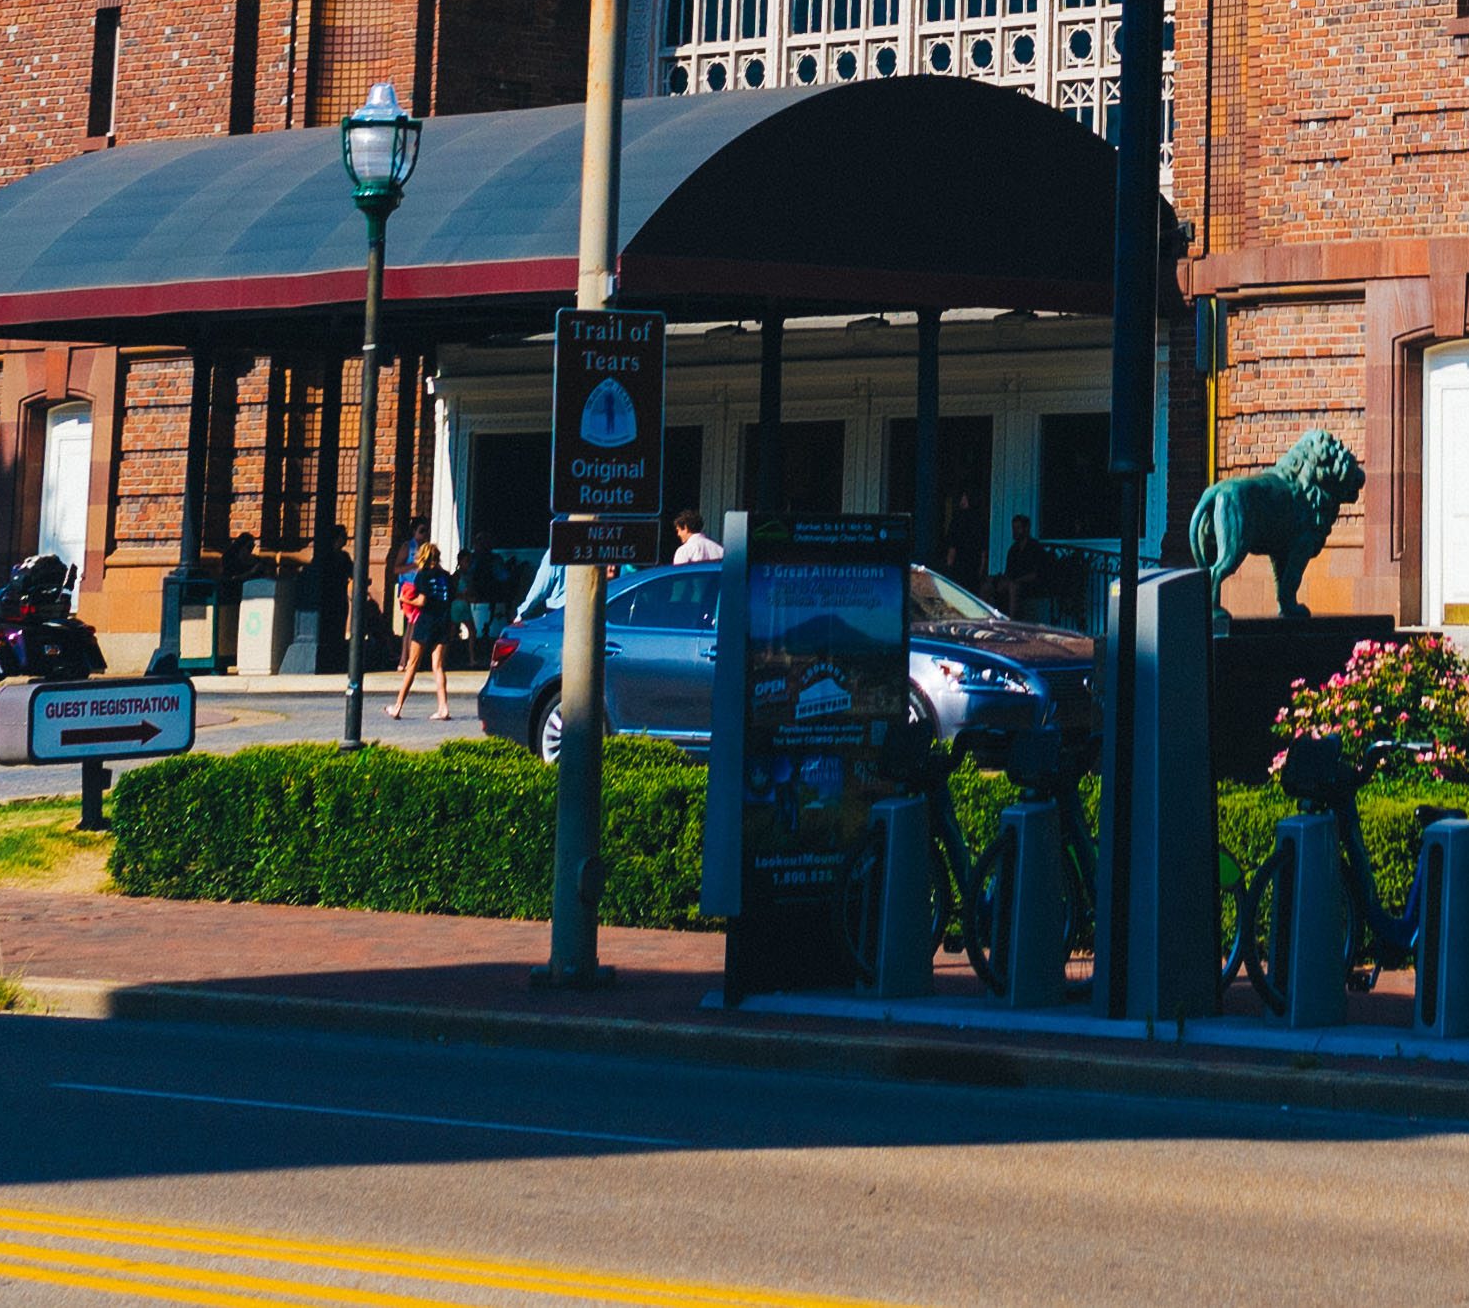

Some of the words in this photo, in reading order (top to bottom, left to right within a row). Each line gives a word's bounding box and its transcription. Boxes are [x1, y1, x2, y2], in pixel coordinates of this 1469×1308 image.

[570, 316, 623, 342] Trail
[630, 319, 653, 342] of
[581, 350, 640, 372] Tears
[571, 458, 645, 484] Original
[579, 484, 635, 505] Route
[588, 526, 624, 541] NEXT
[573, 545, 594, 559] 3.3
[598, 545, 637, 559] MILES
[762, 565, 771, 578] 3
[774, 565, 809, 578] Great
[811, 565, 885, 578] Attractions
[801, 661, 847, 684] LOOKOUT
[754, 677, 786, 697] OPEN
[45, 699, 88, 719] GUEST
[89, 695, 180, 717] REGISTRATION
[798, 697, 849, 716] MOUNTAIN
